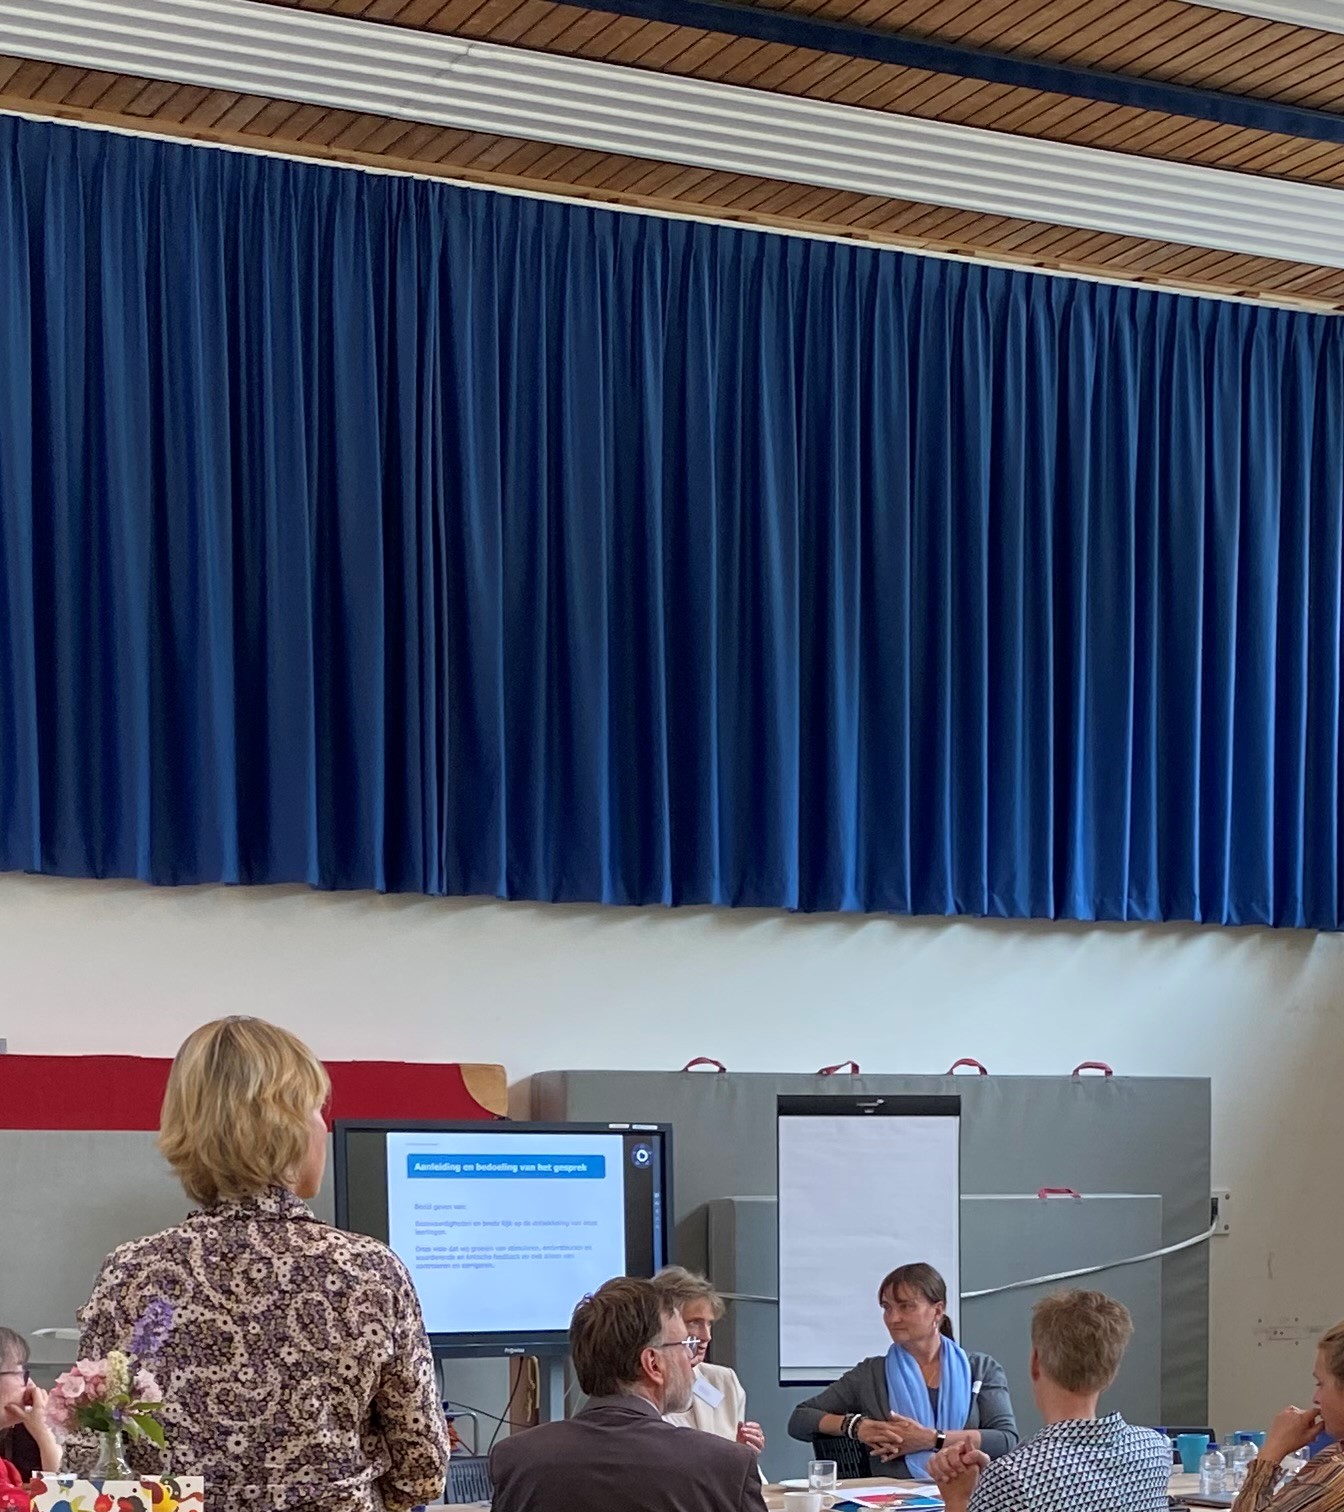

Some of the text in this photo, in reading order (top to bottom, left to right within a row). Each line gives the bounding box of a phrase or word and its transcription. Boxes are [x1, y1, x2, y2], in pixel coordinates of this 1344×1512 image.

[414, 1162, 461, 1173] Aanleiding
[476, 1163, 518, 1173] bedoeling
[537, 1163, 552, 1171] het
[553, 1163, 587, 1173] gesprek
